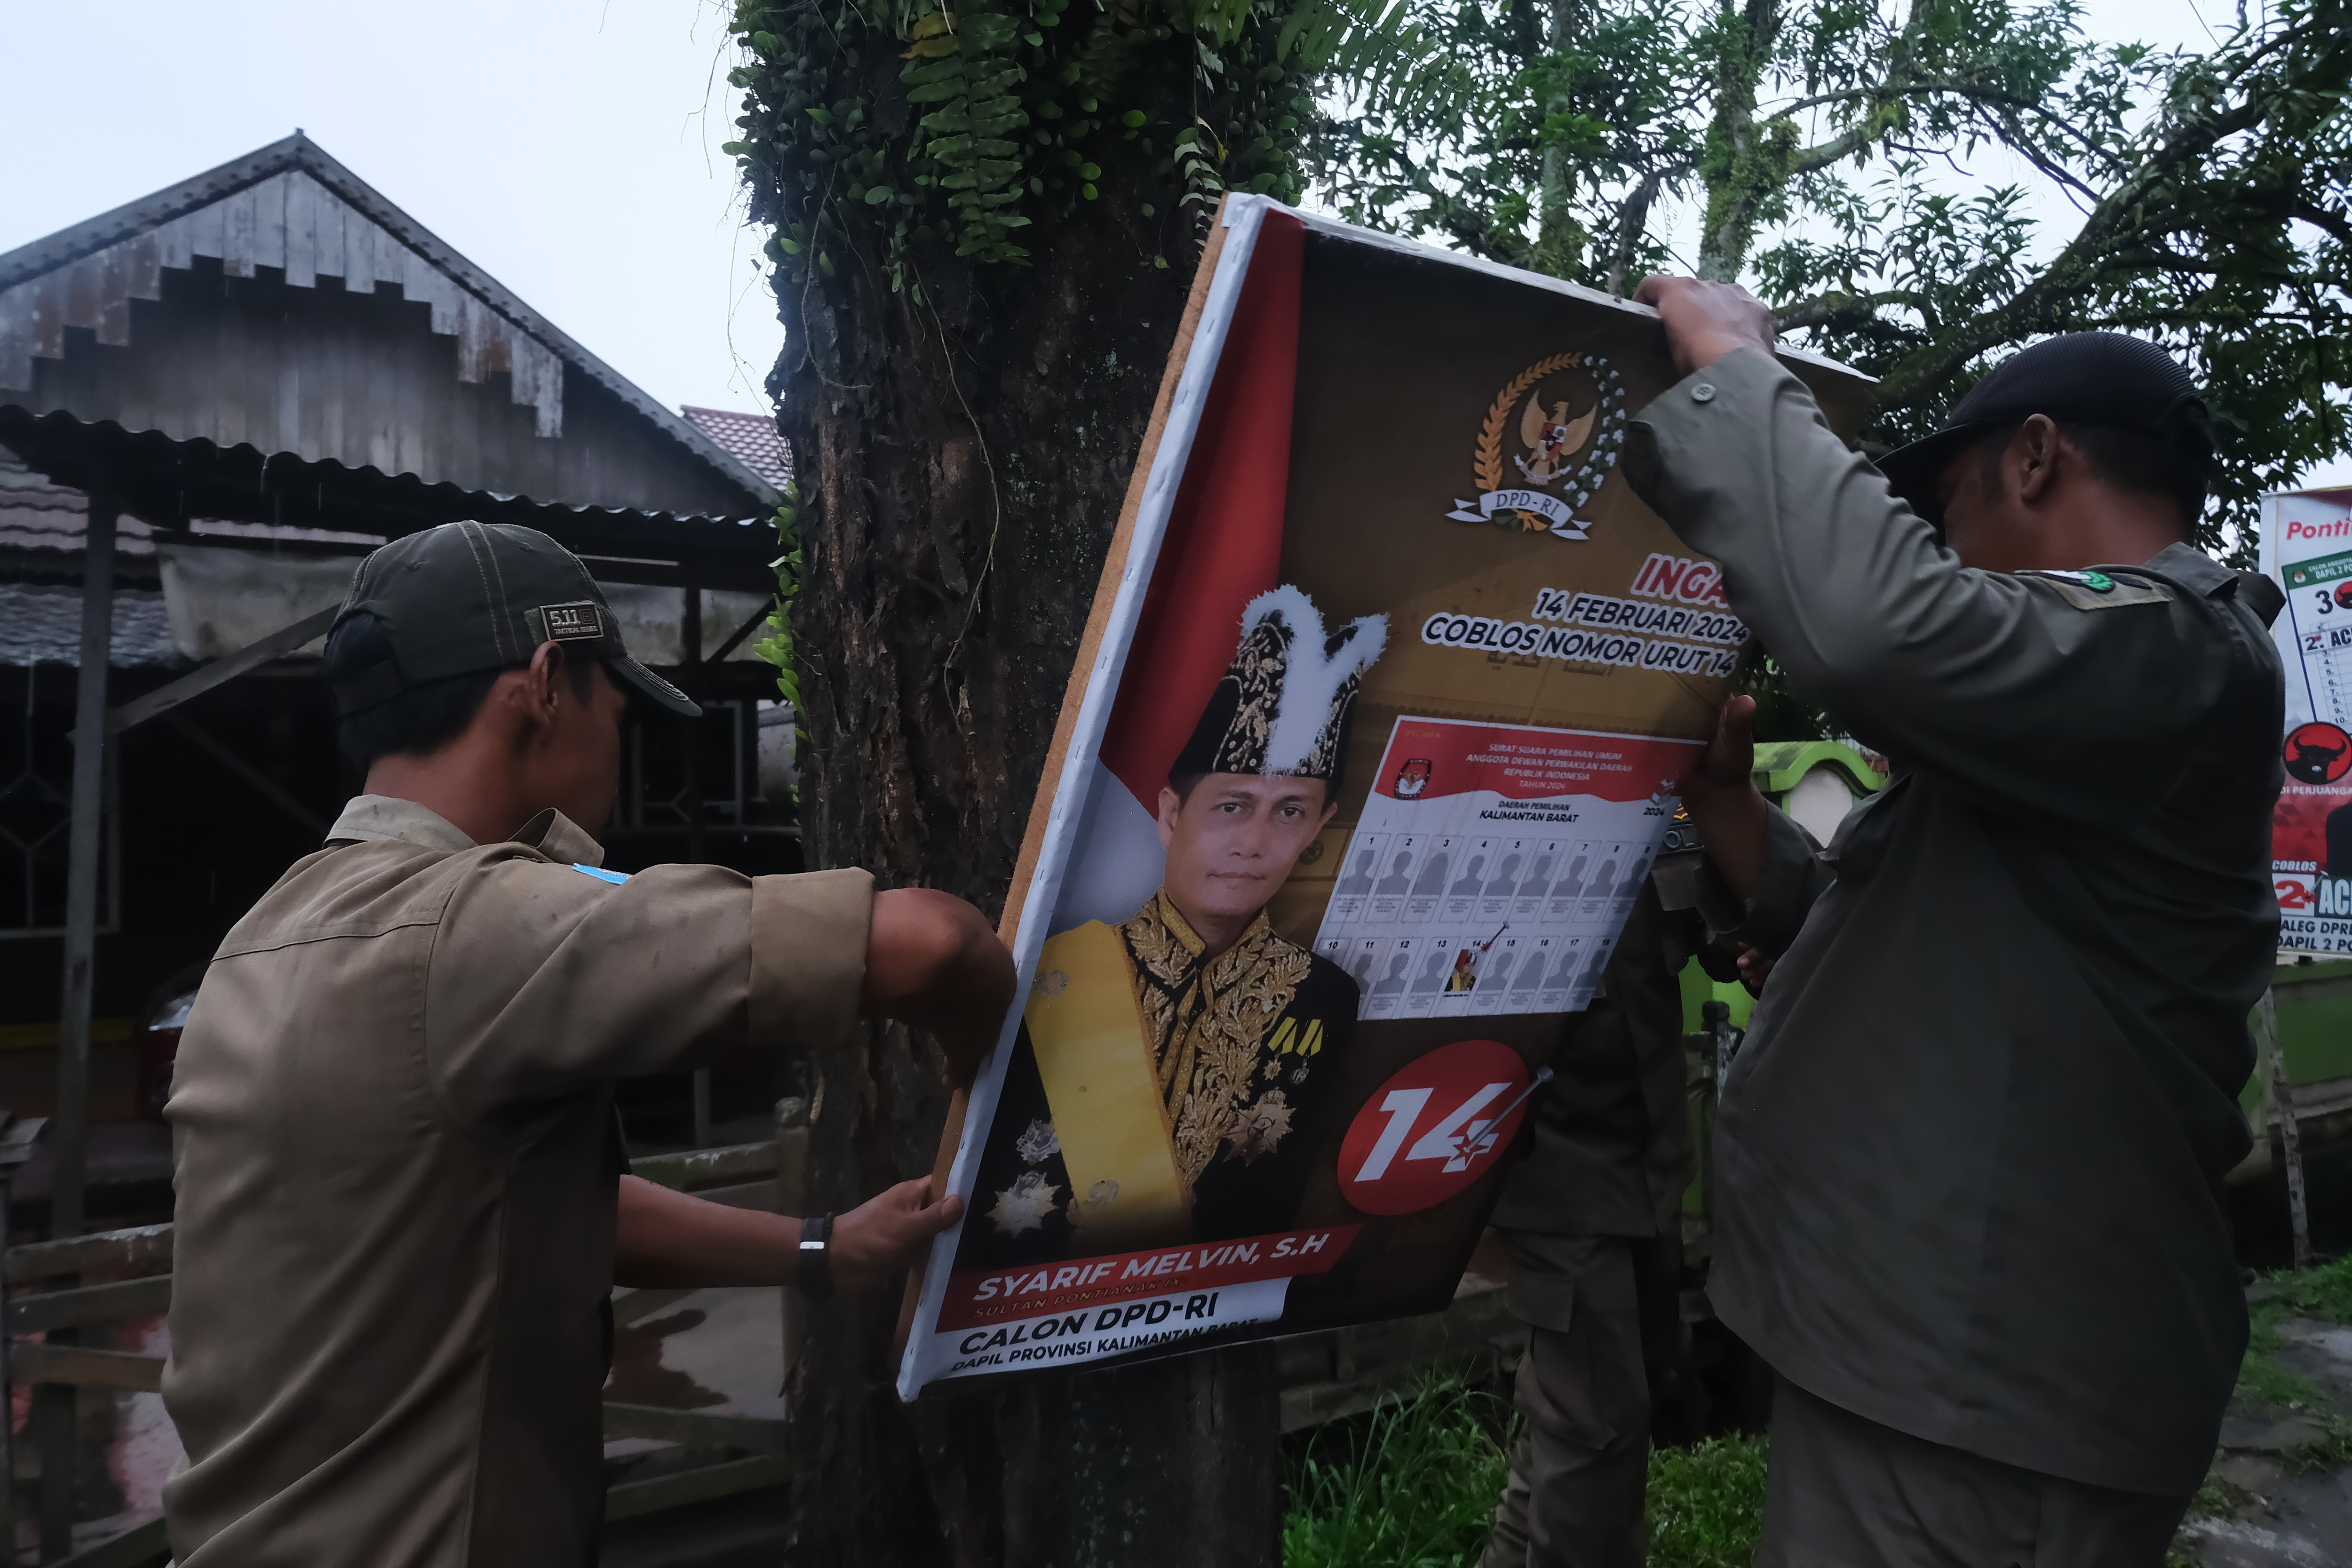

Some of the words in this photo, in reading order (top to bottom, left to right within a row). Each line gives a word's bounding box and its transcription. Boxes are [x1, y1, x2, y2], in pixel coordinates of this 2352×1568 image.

[1496, 493, 1560, 516] DPD-RI
[2287, 517, 2352, 540] Ponti
[1635, 558, 1727, 603] INGA
[2315, 567, 2337, 580] DAPIL
[2337, 565, 2343, 574] 2
[2315, 590, 2333, 614] 3
[549, 609, 581, 627] 5.11
[1537, 592, 1565, 617] 14
[1565, 597, 1694, 633] FEBRUARI
[1695, 616, 1747, 642] 2024
[1426, 617, 1539, 650] COBLOS
[1541, 631, 1640, 662] NOMOR
[1646, 644, 1713, 671] URUT
[1709, 653, 1732, 674] 14
[2331, 628, 2352, 646] AC
[1488, 743, 1517, 753] SURAT
[1548, 748, 1594, 758] PEMILIHAN
[1466, 754, 1510, 764] ANGGOTA
[1511, 756, 1544, 766] DEWAN
[1544, 759, 1598, 770] PERWAKILAN
[1599, 763, 1633, 772] DAERAH
[1504, 768, 1544, 778] REPUBLIK
[1545, 771, 1590, 780] INDONESIA
[1519, 780, 1547, 789] TAHUN
[1498, 800, 1530, 809] DAERAH
[1530, 802, 1571, 811] PEMILIHAN
[1643, 807, 1665, 816] 2024
[1479, 810, 1545, 821] KALIMANTAN
[1546, 813, 1580, 823] BARAT
[1663, 828, 1695, 848] OL
[2272, 860, 2318, 872] COBLOS
[2274, 880, 2304, 908] 2
[2319, 879, 2352, 915] AC
[2281, 920, 2315, 933] ALEG
[2323, 938, 2331, 950] 2
[1353, 1082, 1513, 1182] 14
[973, 1261, 1118, 1301] SYARIF
[1120, 1242, 1261, 1280] MELVIN,
[1270, 1233, 1330, 1258] S.H
[974, 1298, 1048, 1319] SULTAN
[1052, 1279, 1161, 1306] PONTIANAK
[960, 1313, 1089, 1355] CALON
[1094, 1292, 1219, 1331] DPD-RI
[950, 1352, 1003, 1372] DAPIL
[1009, 1341, 1091, 1363] PROVINSI
[1097, 1326, 1203, 1353] KALIMANTAN
